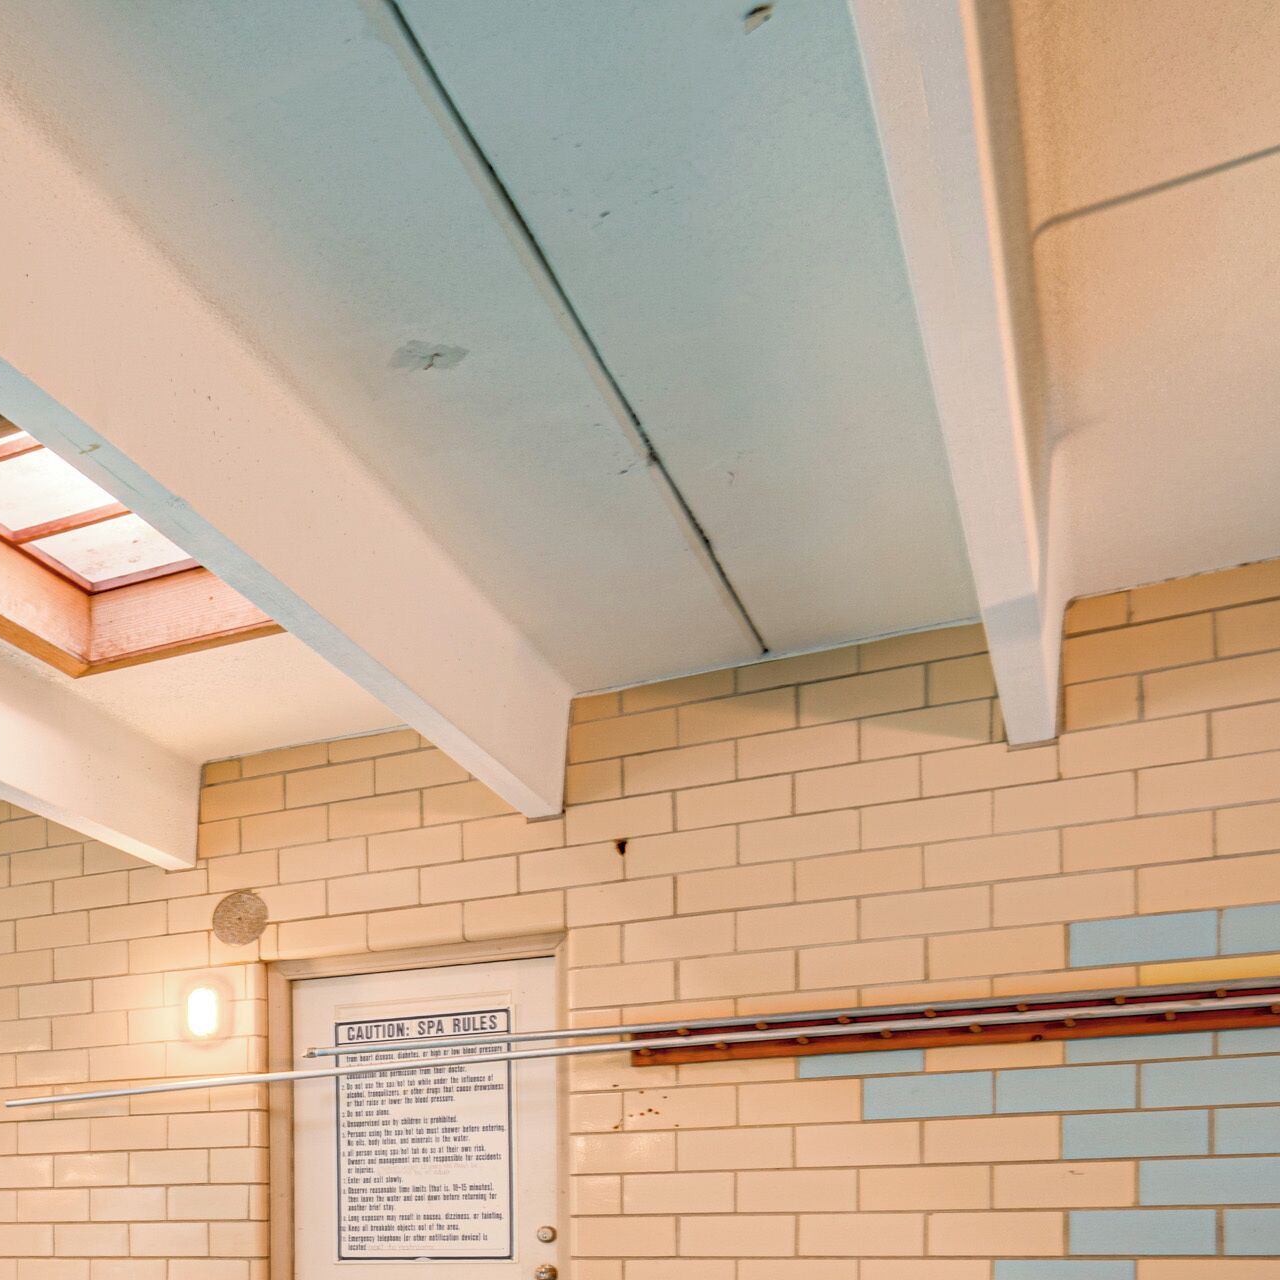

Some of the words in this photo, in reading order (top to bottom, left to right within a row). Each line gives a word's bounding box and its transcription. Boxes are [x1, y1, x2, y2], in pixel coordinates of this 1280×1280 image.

[347, 1023, 409, 1041] CAUTION:
[418, 1020, 444, 1036] SPA
[453, 1015, 497, 1032] RULES
